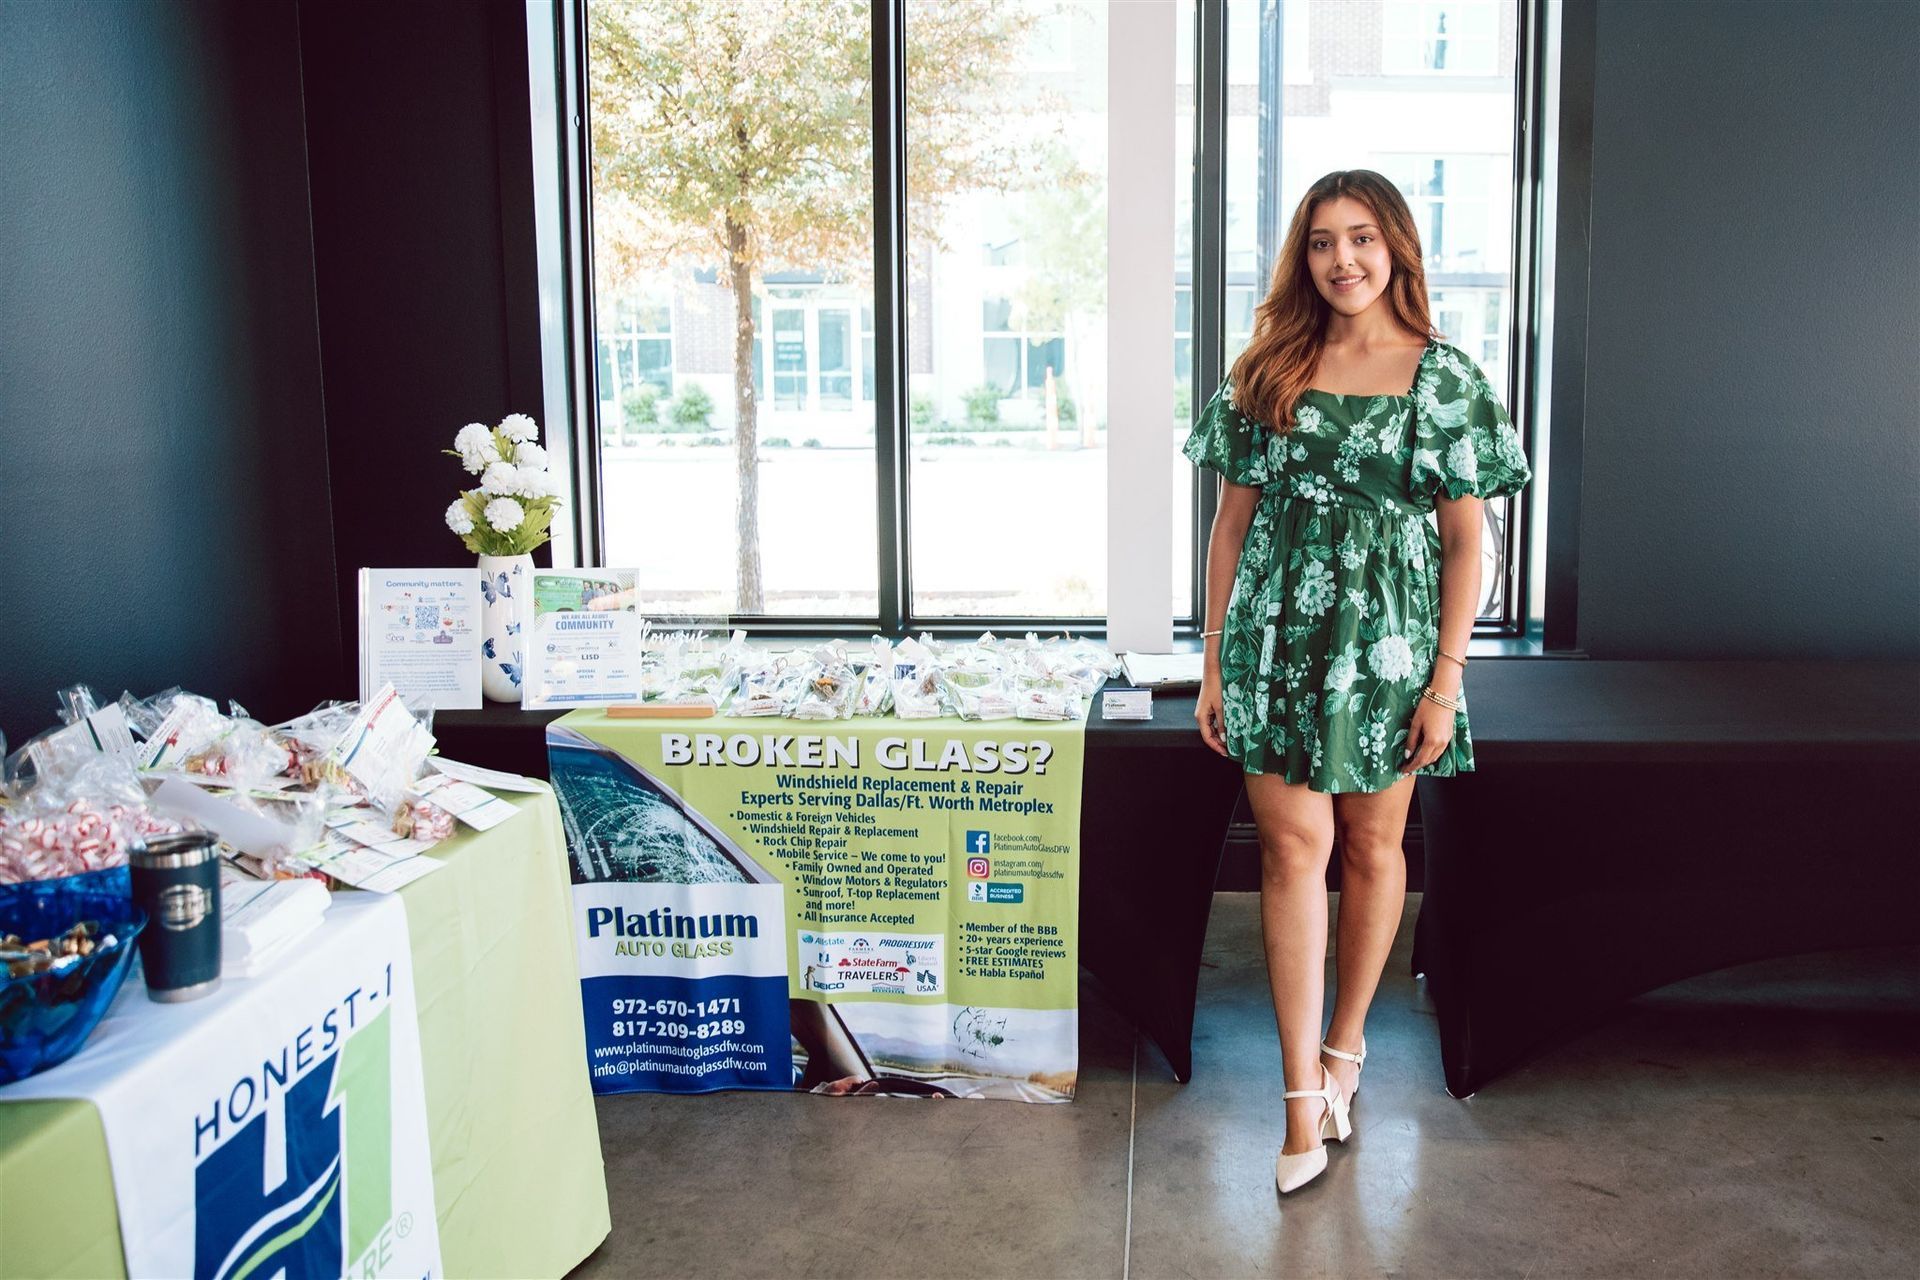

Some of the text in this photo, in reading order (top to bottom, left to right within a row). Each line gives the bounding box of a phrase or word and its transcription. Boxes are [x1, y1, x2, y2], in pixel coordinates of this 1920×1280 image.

[386, 580, 430, 588] Community
[556, 620, 614, 630] COMMUNITY
[661, 733, 1054, 776] BROKEN GLASS?
[776, 774, 1024, 798] Windshield Replacement & Repair
[742, 791, 1054, 815] Experts Serving Dallas/Ft. Worth Metroplex
[737, 811, 876, 824] Domestic & Foreign Vehicles
[750, 824, 918, 838] Windshield Repair & Replacement
[763, 836, 847, 850] Rock Chip Repair
[994, 843, 1070, 854] PlatinumAutoGlassDFW
[776, 849, 810, 859] Mobile
[813, 850, 848, 861] Service
[861, 851, 877, 861] We
[881, 854, 907, 862] come
[910, 853, 920, 862] to
[924, 853, 946, 865] you!
[792, 862, 933, 876] Family Owned and Operated
[994, 868, 1064, 879] platinumautoglassdfw
[802, 874, 947, 889] Window Motors & Regulators
[803, 886, 940, 900] Sunroof, T-top Replacement
[806, 900, 855, 910] and more!
[587, 906, 758, 939] Platinum
[804, 911, 915, 925] All Insurance Accepted
[966, 922, 1058, 935] Member of the BBB
[879, 939, 935, 949] PROGRESSIVE
[966, 934, 1064, 947] 20+ years experience
[615, 940, 734, 959] AUTO GLASS
[966, 946, 1066, 958] 5-star Google reviews
[966, 957, 1044, 968] FREE ESTIMATES
[838, 971, 898, 981] TRAVELERS
[966, 967, 1044, 980] Se Habla Español
[814, 981, 844, 990] GEICO
[612, 998, 740, 1018] 972-670-1471
[612, 1020, 746, 1039] 817-209-8289
[595, 1040, 764, 1060] www.platinumautoglassdfw.com
[195, 963, 392, 1158] HONEST-1
[594, 1057, 766, 1078] info@platinumautoglassdfw.com
